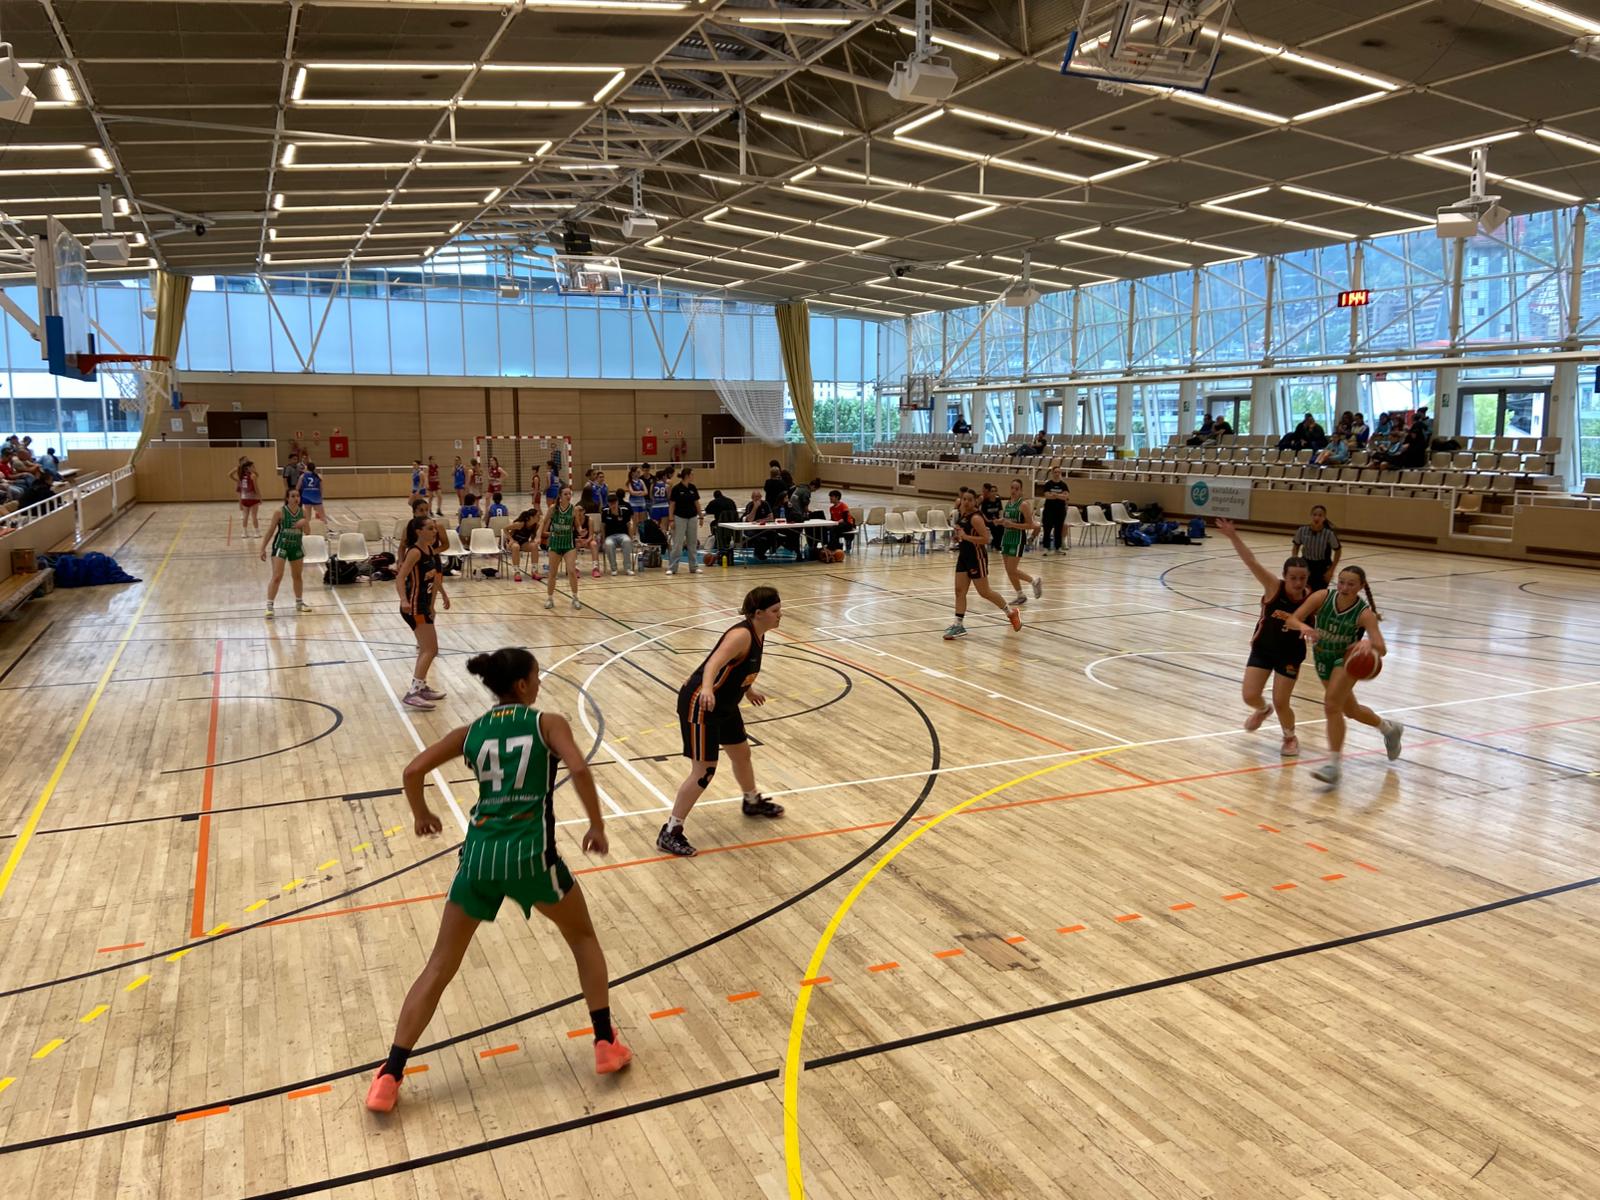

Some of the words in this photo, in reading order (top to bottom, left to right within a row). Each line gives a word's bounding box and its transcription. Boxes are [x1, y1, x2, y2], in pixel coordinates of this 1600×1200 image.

[307, 477, 314, 487] 2
[654, 486, 666, 497] 28
[1192, 487, 1207, 501] ee
[476, 735, 534, 792] 47
